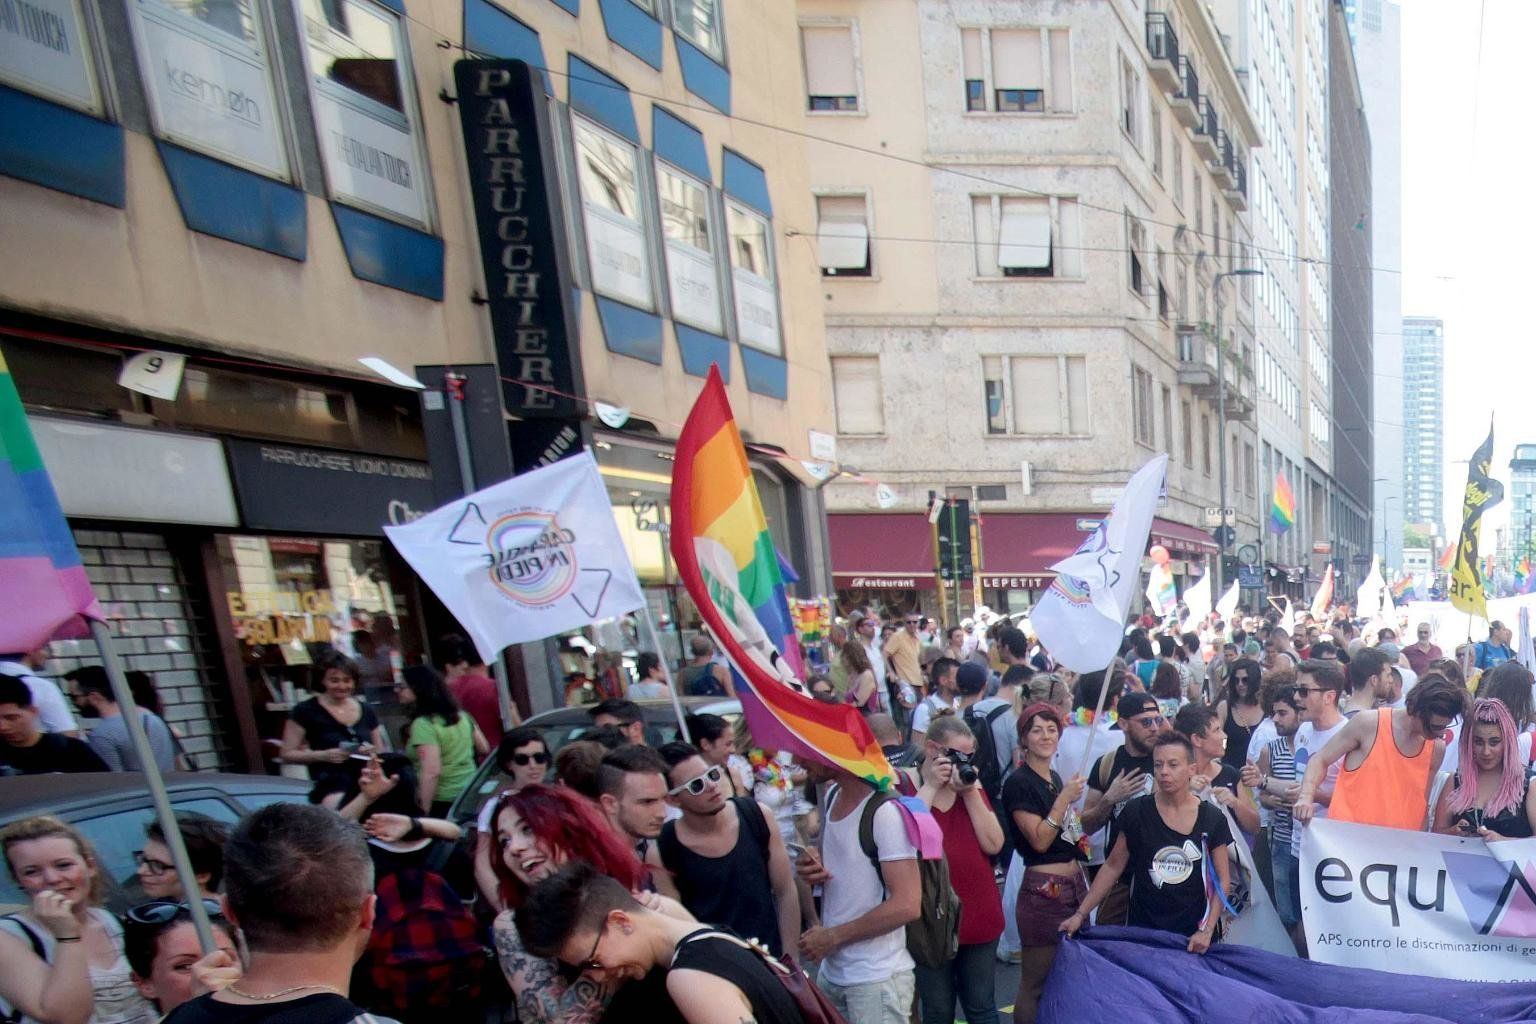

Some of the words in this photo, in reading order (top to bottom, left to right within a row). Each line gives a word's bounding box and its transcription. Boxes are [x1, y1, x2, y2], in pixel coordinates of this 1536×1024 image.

[474, 69, 556, 410] PARRUCCHIERE
[850, 577, 916, 589] Restaurant
[983, 577, 1043, 588] LEPETIT
[1317, 933, 1342, 946] APS
[1346, 936, 1391, 949] contro
[1396, 936, 1408, 949] le
[1412, 937, 1502, 953] discriminazioni
[1506, 945, 1518, 953] di
